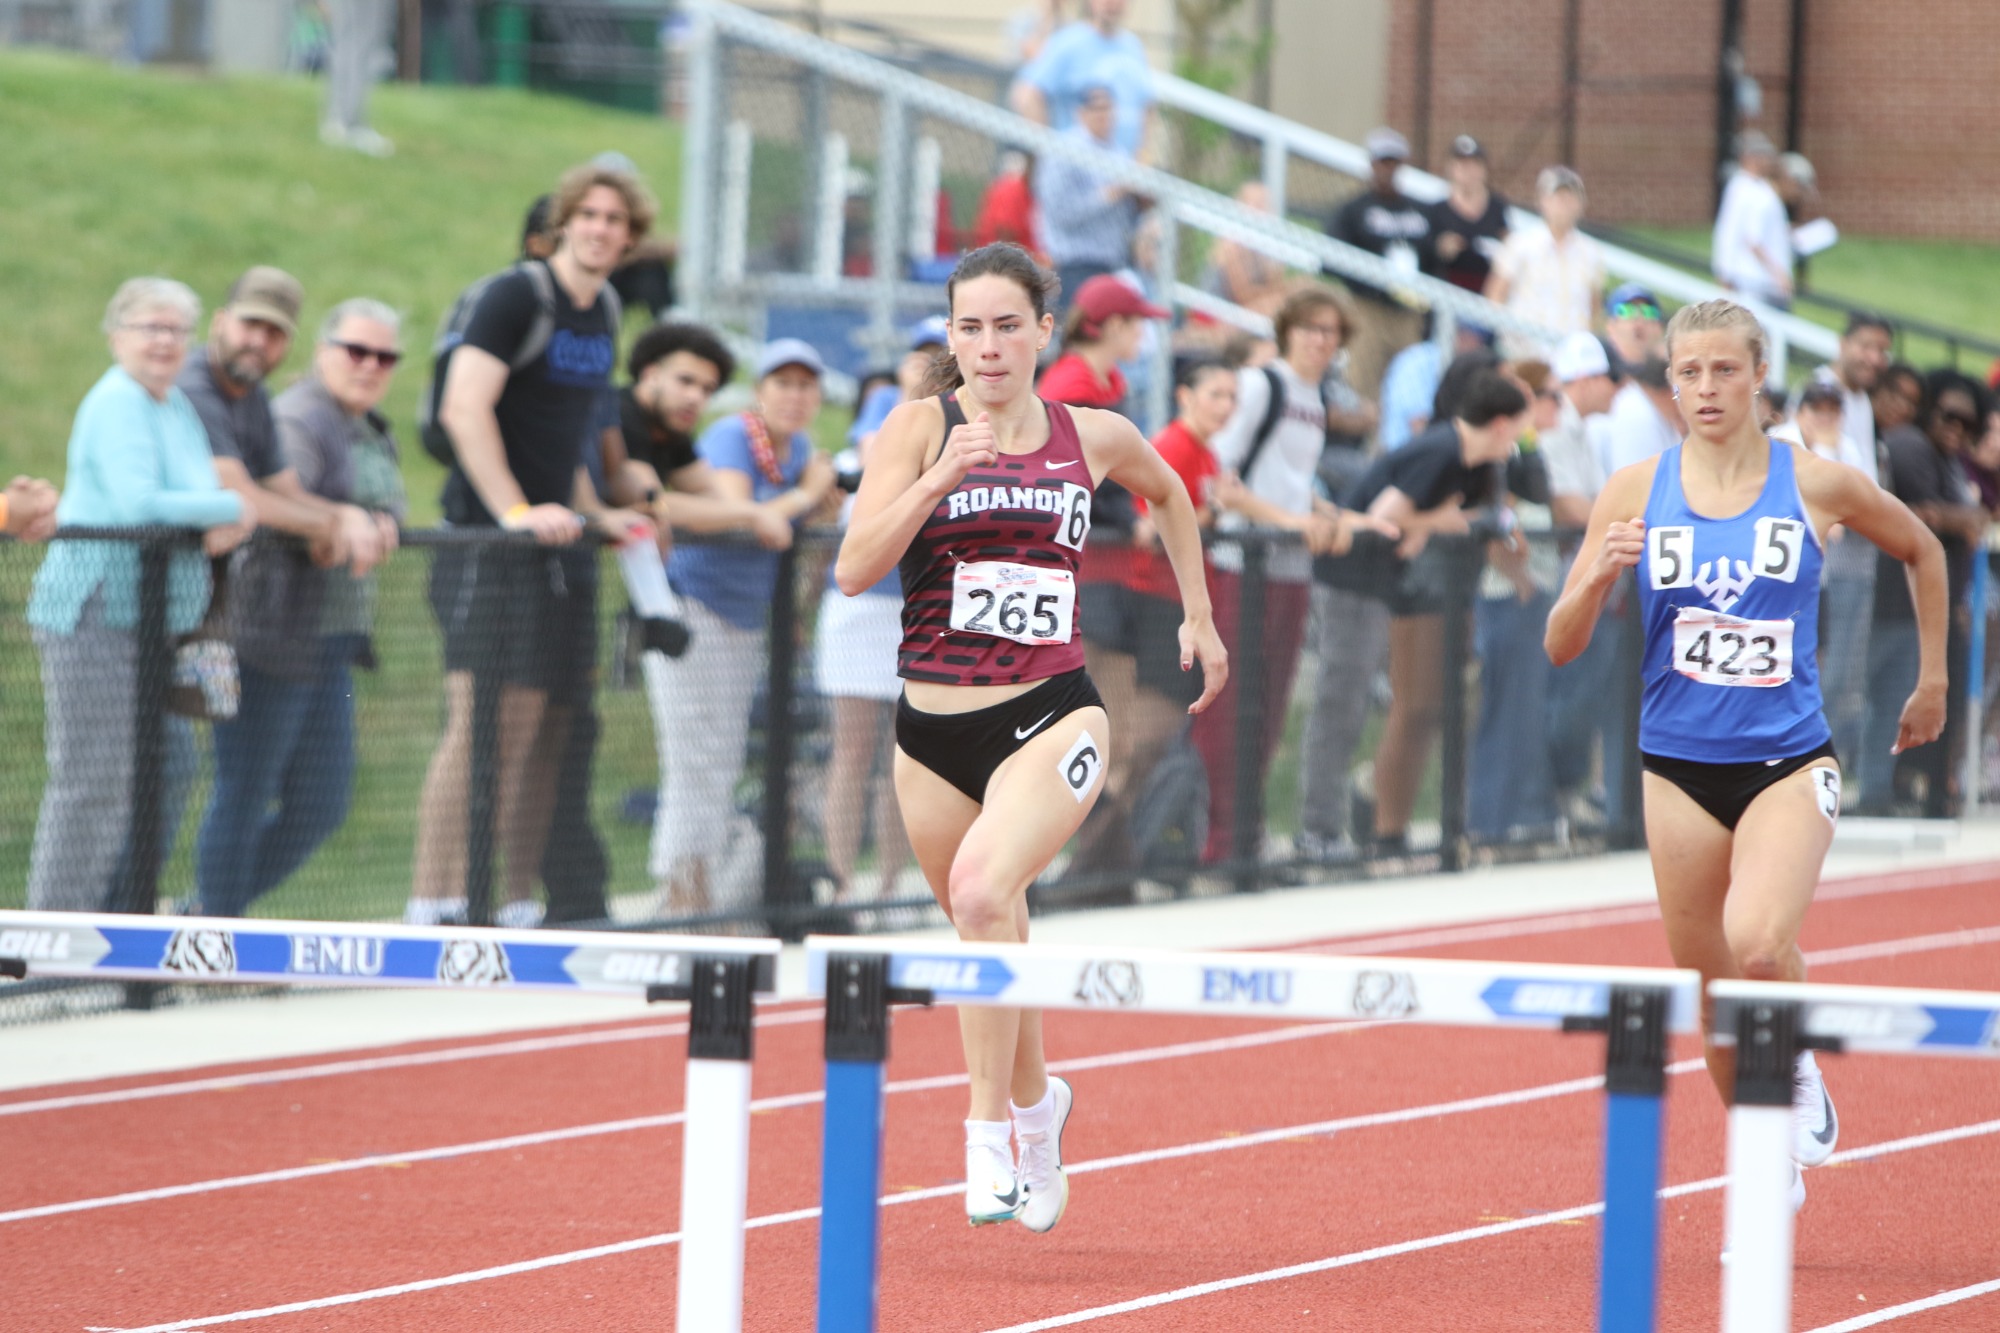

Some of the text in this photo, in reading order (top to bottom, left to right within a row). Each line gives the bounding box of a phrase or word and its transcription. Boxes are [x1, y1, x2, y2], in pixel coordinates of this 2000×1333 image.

[1067, 490, 1087, 547] 6
[1659, 530, 1682, 585] 5
[1765, 522, 1795, 576] 5
[964, 588, 1060, 638] 265
[1685, 629, 1778, 676] 423
[1067, 746, 1097, 789] 6
[292, 933, 384, 976] EMU
[1201, 966, 1295, 1005] EMU
